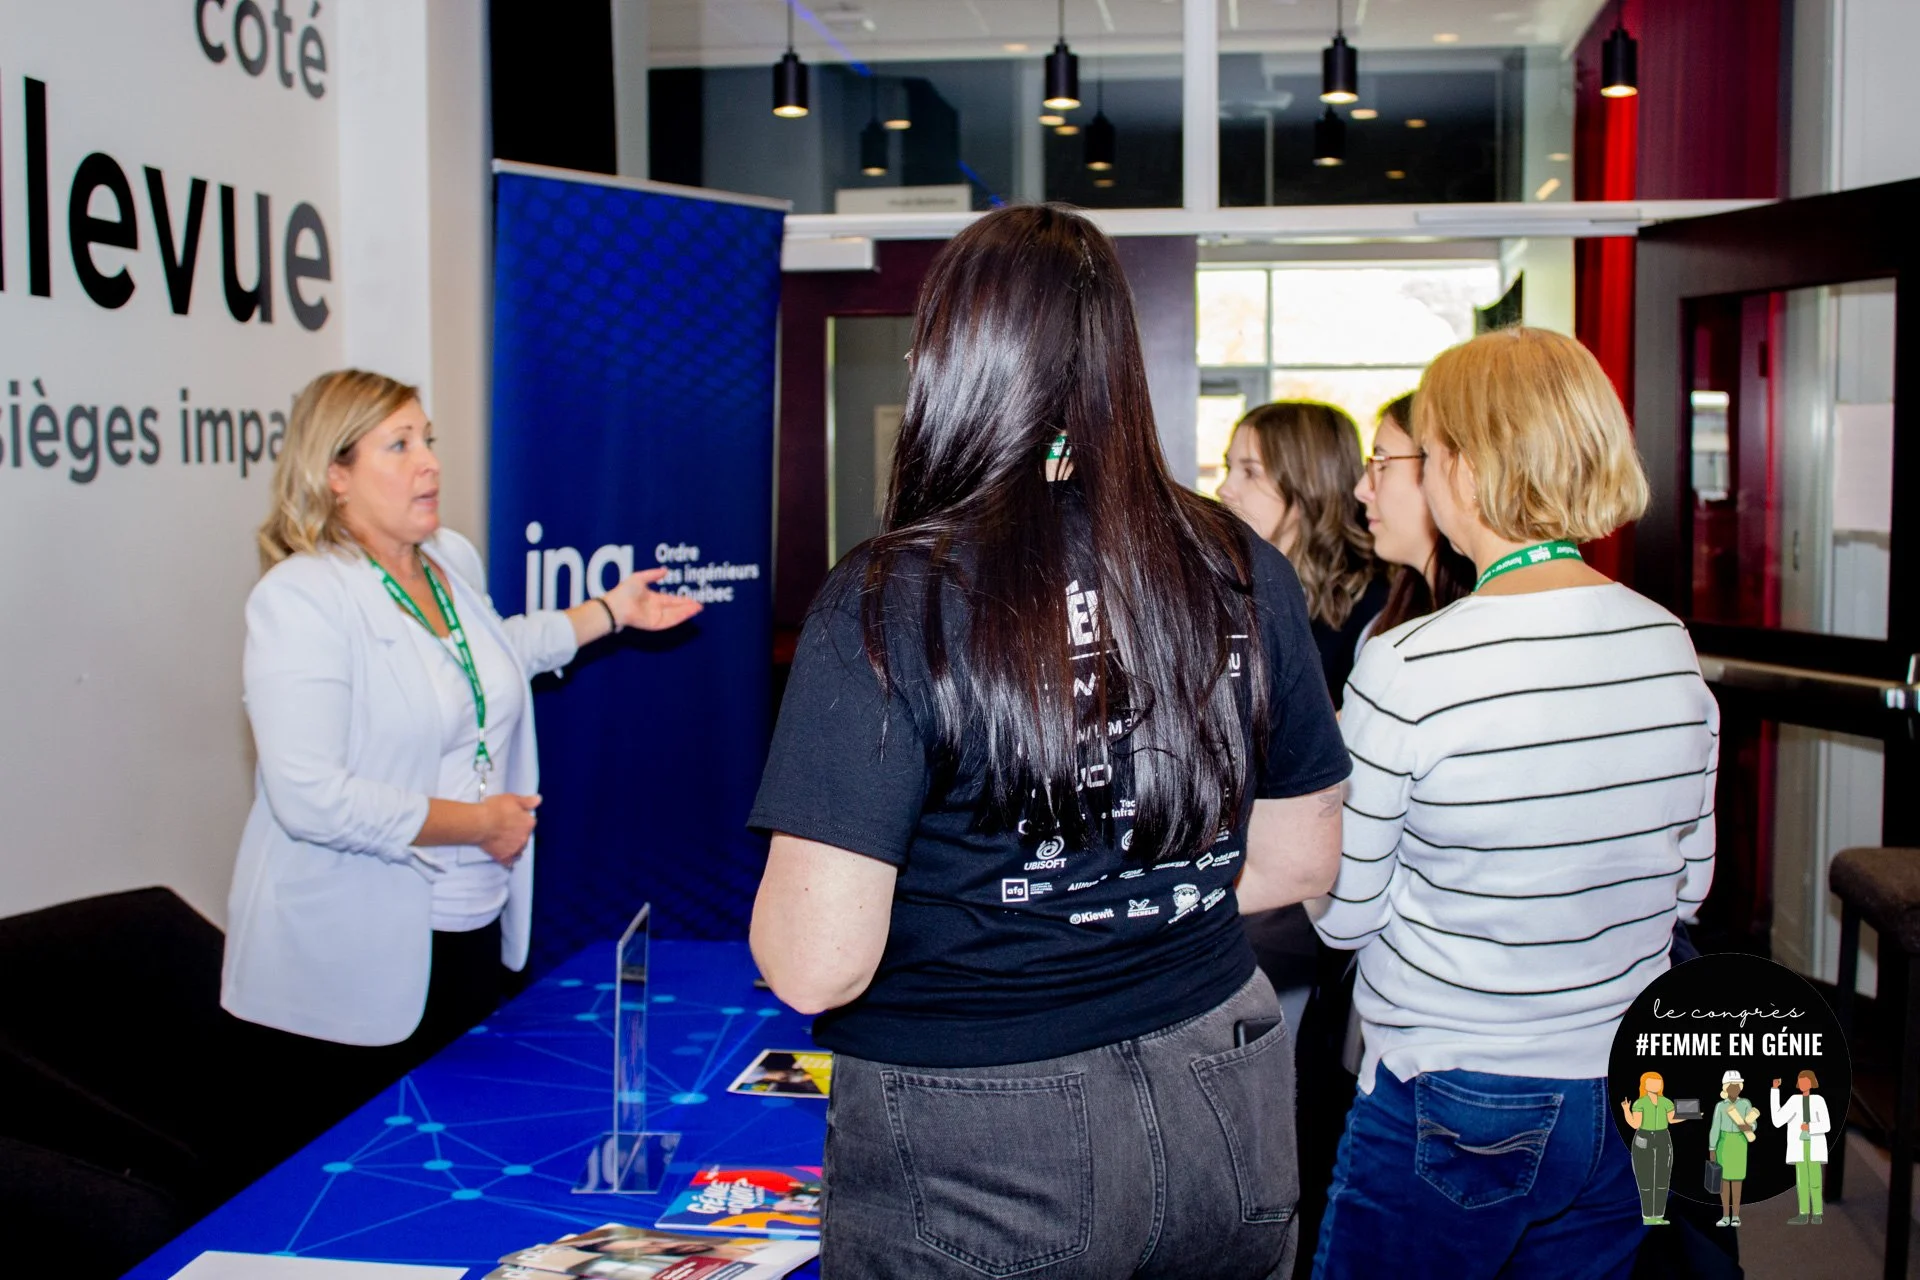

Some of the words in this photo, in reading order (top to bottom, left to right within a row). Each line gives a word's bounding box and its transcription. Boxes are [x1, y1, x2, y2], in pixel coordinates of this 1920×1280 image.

[0, 74, 332, 332] levue
[0, 378, 161, 484] ièges
[180, 387, 289, 478] impa
[655, 542, 700, 563] Ordre
[657, 567, 683, 585] es
[684, 561, 760, 586] ingénieurs
[1024, 858, 1067, 870] UBISOFT
[1081, 908, 1114, 923] Kiewit
[1128, 908, 1159, 917] MICHELIN
